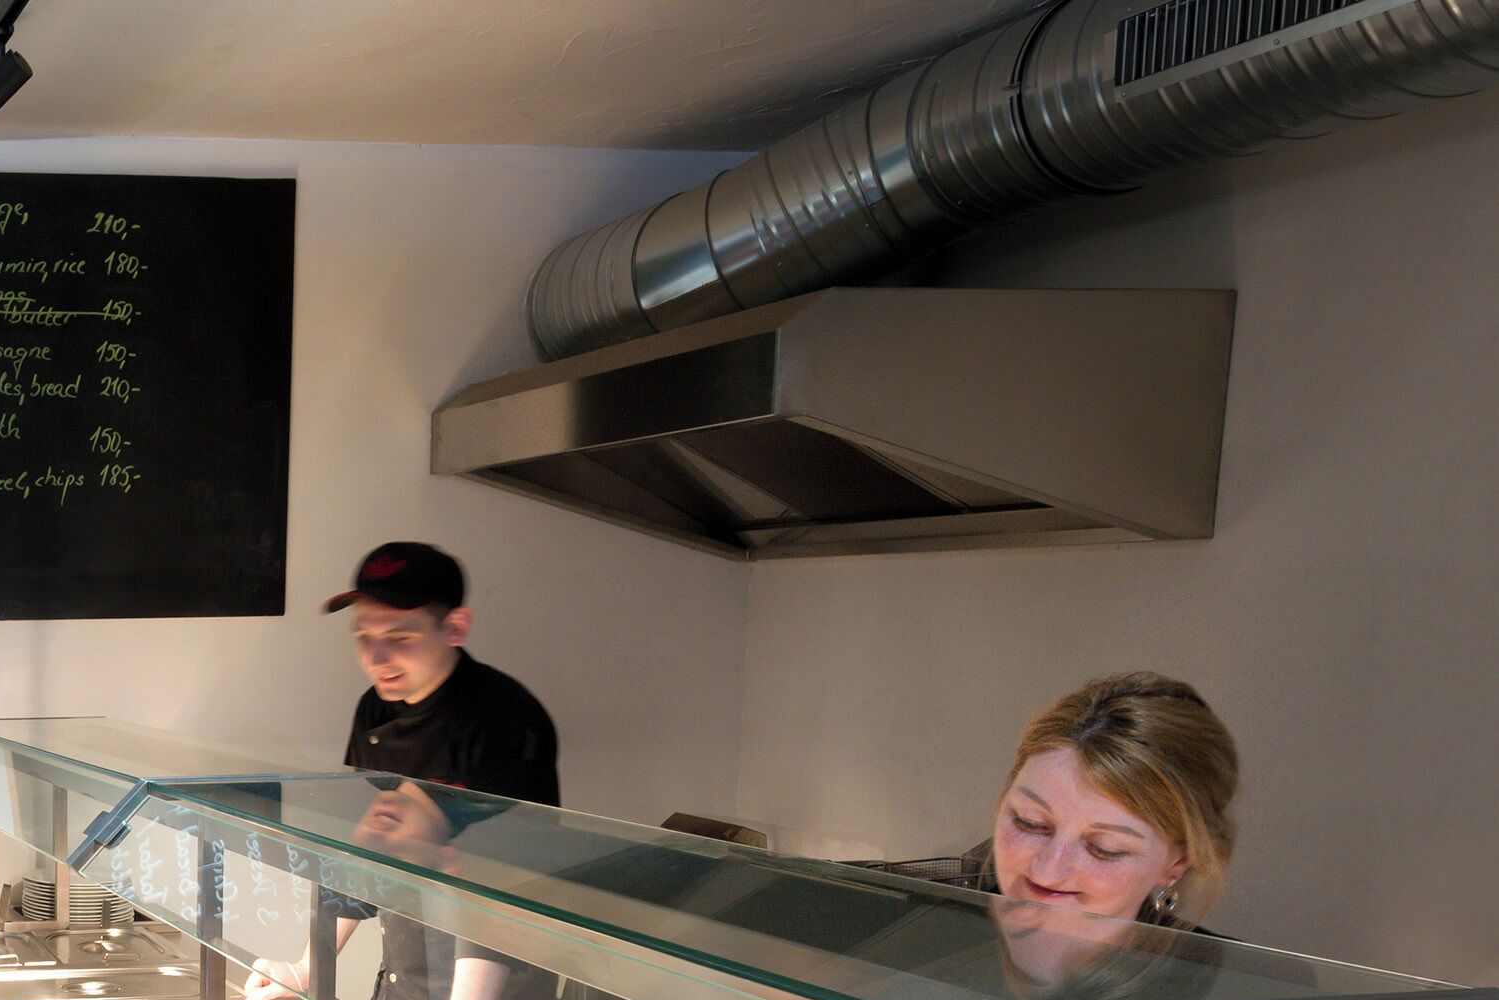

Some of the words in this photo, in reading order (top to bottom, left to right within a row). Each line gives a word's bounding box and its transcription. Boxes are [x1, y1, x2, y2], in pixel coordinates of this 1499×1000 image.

[87, 212, 141, 241] 210,-
[53, 253, 87, 274] rice
[104, 251, 148, 279] 180,-
[96, 340, 136, 369] 150,-
[30, 374, 81, 399] bread
[100, 377, 141, 404] 210,-
[89, 425, 132, 457] 150,-
[35, 466, 84, 506] chips
[100, 464, 141, 493] 185,-
